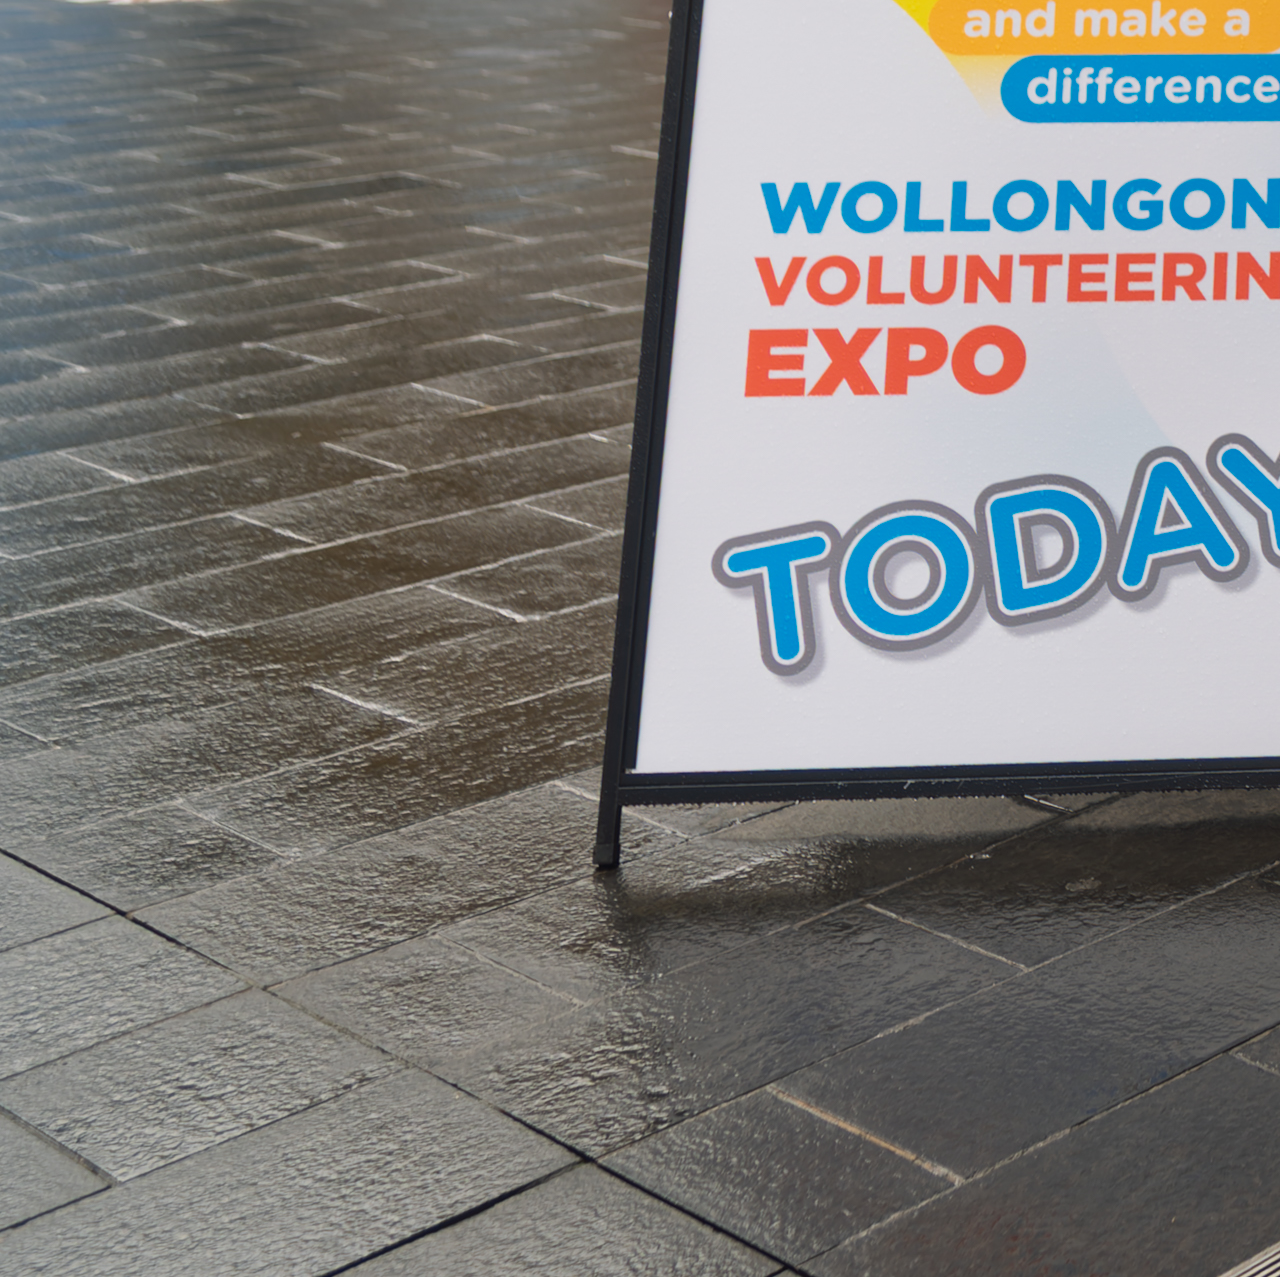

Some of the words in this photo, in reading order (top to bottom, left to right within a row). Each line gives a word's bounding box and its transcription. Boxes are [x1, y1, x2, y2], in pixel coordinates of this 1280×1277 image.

[963, 0, 1056, 39] and
[1073, 0, 1207, 38] make
[1223, 8, 1251, 38] a
[1026, 67, 1280, 105] difference
[744, 325, 1027, 398] EXPO
